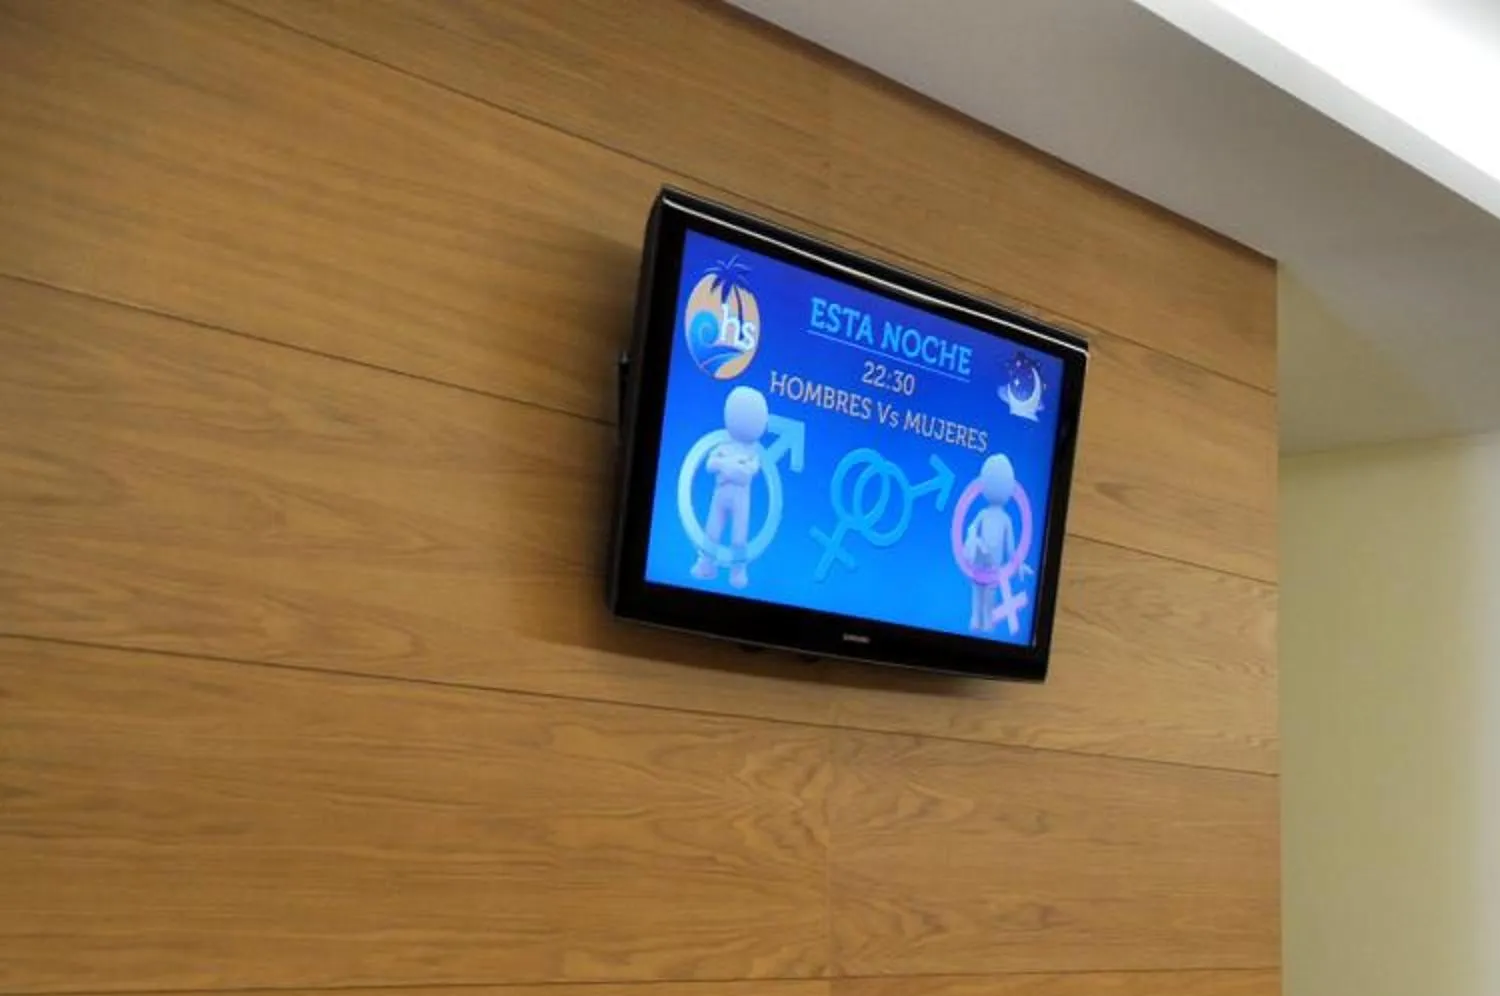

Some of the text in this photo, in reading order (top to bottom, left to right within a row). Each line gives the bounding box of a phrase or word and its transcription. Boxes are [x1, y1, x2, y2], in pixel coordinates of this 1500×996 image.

[810, 297, 973, 375] ESTA NOCHE
[770, 370, 989, 453] HOMBRES Vs MUJERES
[861, 360, 916, 396] 22:30
